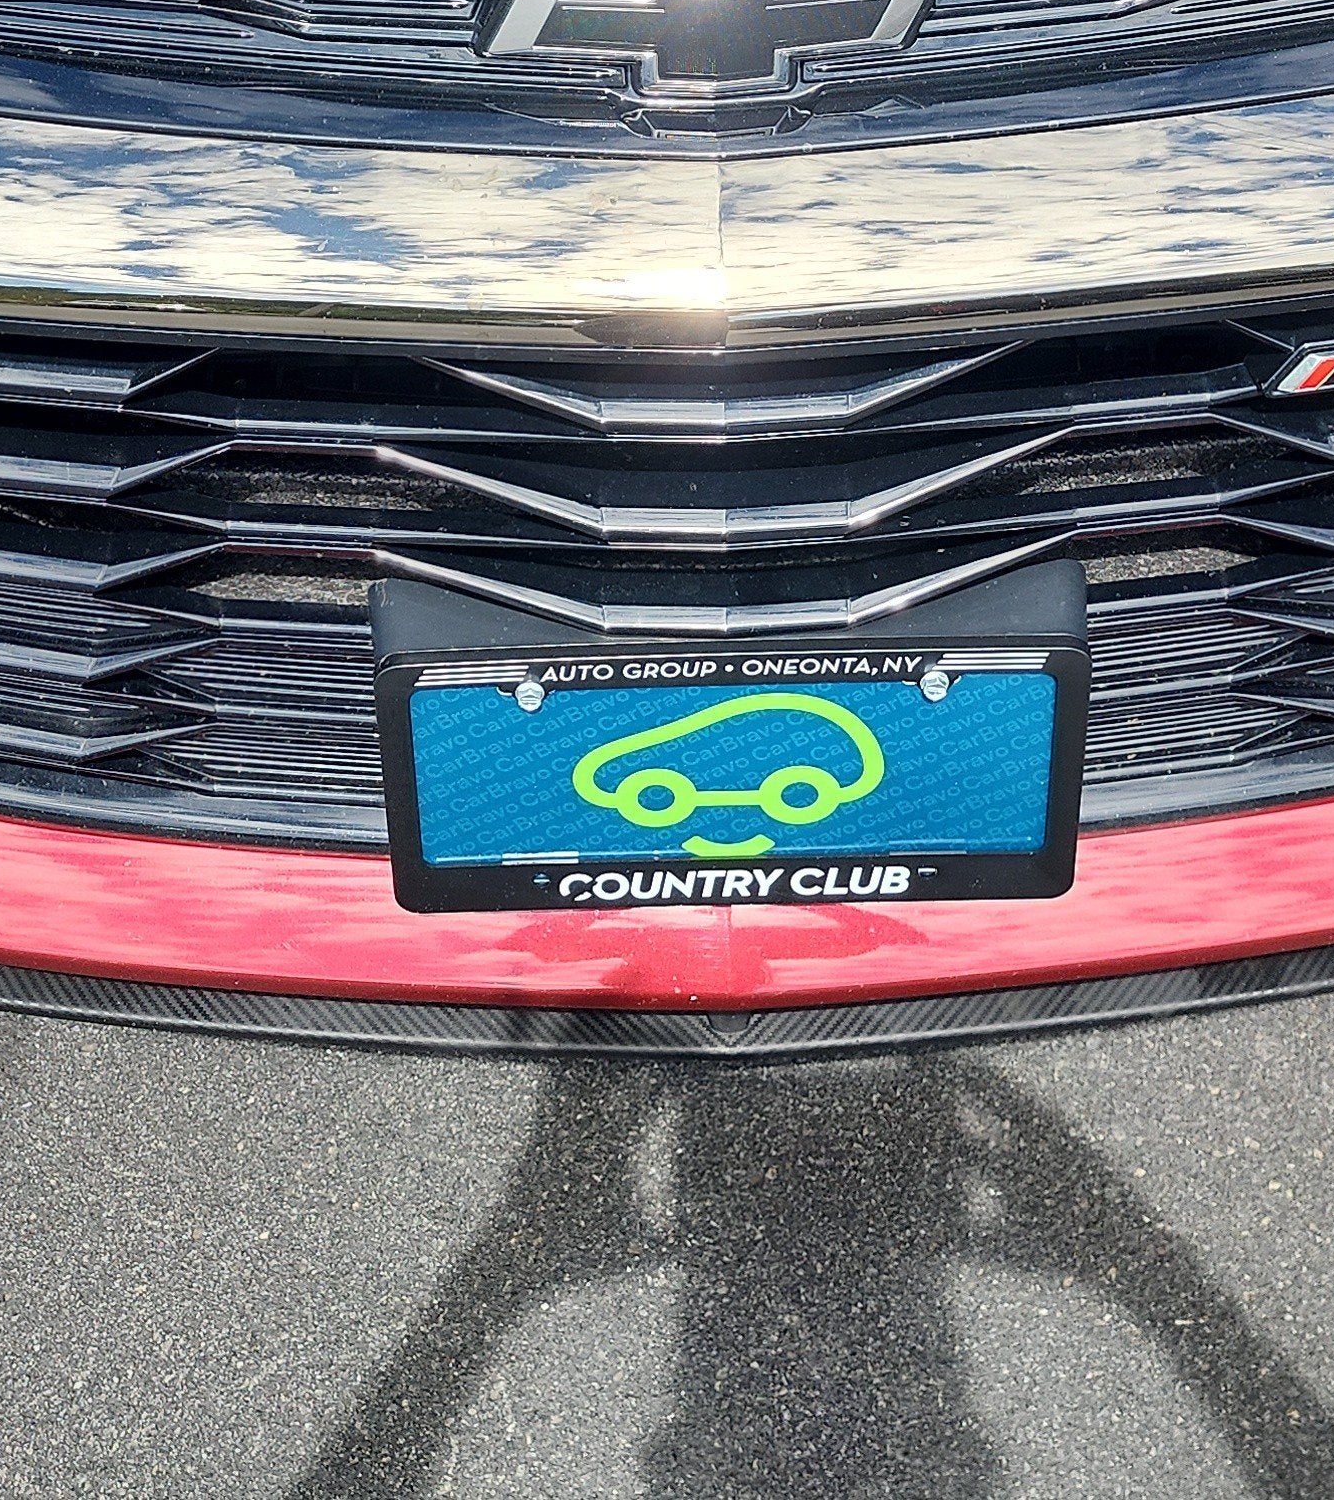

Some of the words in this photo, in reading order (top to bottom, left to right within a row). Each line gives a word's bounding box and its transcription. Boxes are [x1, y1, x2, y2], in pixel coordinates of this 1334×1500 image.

[539, 662, 614, 684] AUTO
[621, 659, 717, 681] GROUP
[739, 656, 880, 678] ONEONTA,
[881, 655, 924, 674] NY
[916, 674, 1019, 721] CarBravo
[424, 731, 527, 778] CarBravo
[526, 691, 629, 738] CarBravo
[494, 726, 597, 773] CarBravo
[598, 686, 701, 733] CarBravo
[881, 709, 984, 756] CarBravo
[939, 708, 1042, 756] CarBravo
[450, 765, 553, 812] CarBravo
[476, 799, 579, 846] CarBravo
[681, 720, 784, 767] CarBravo
[904, 743, 1007, 790] CarBravo
[857, 782, 960, 829] CarBravo
[927, 777, 1030, 824] CarBravo
[558, 868, 786, 902] COUNTRY
[789, 865, 911, 897] CLUB
